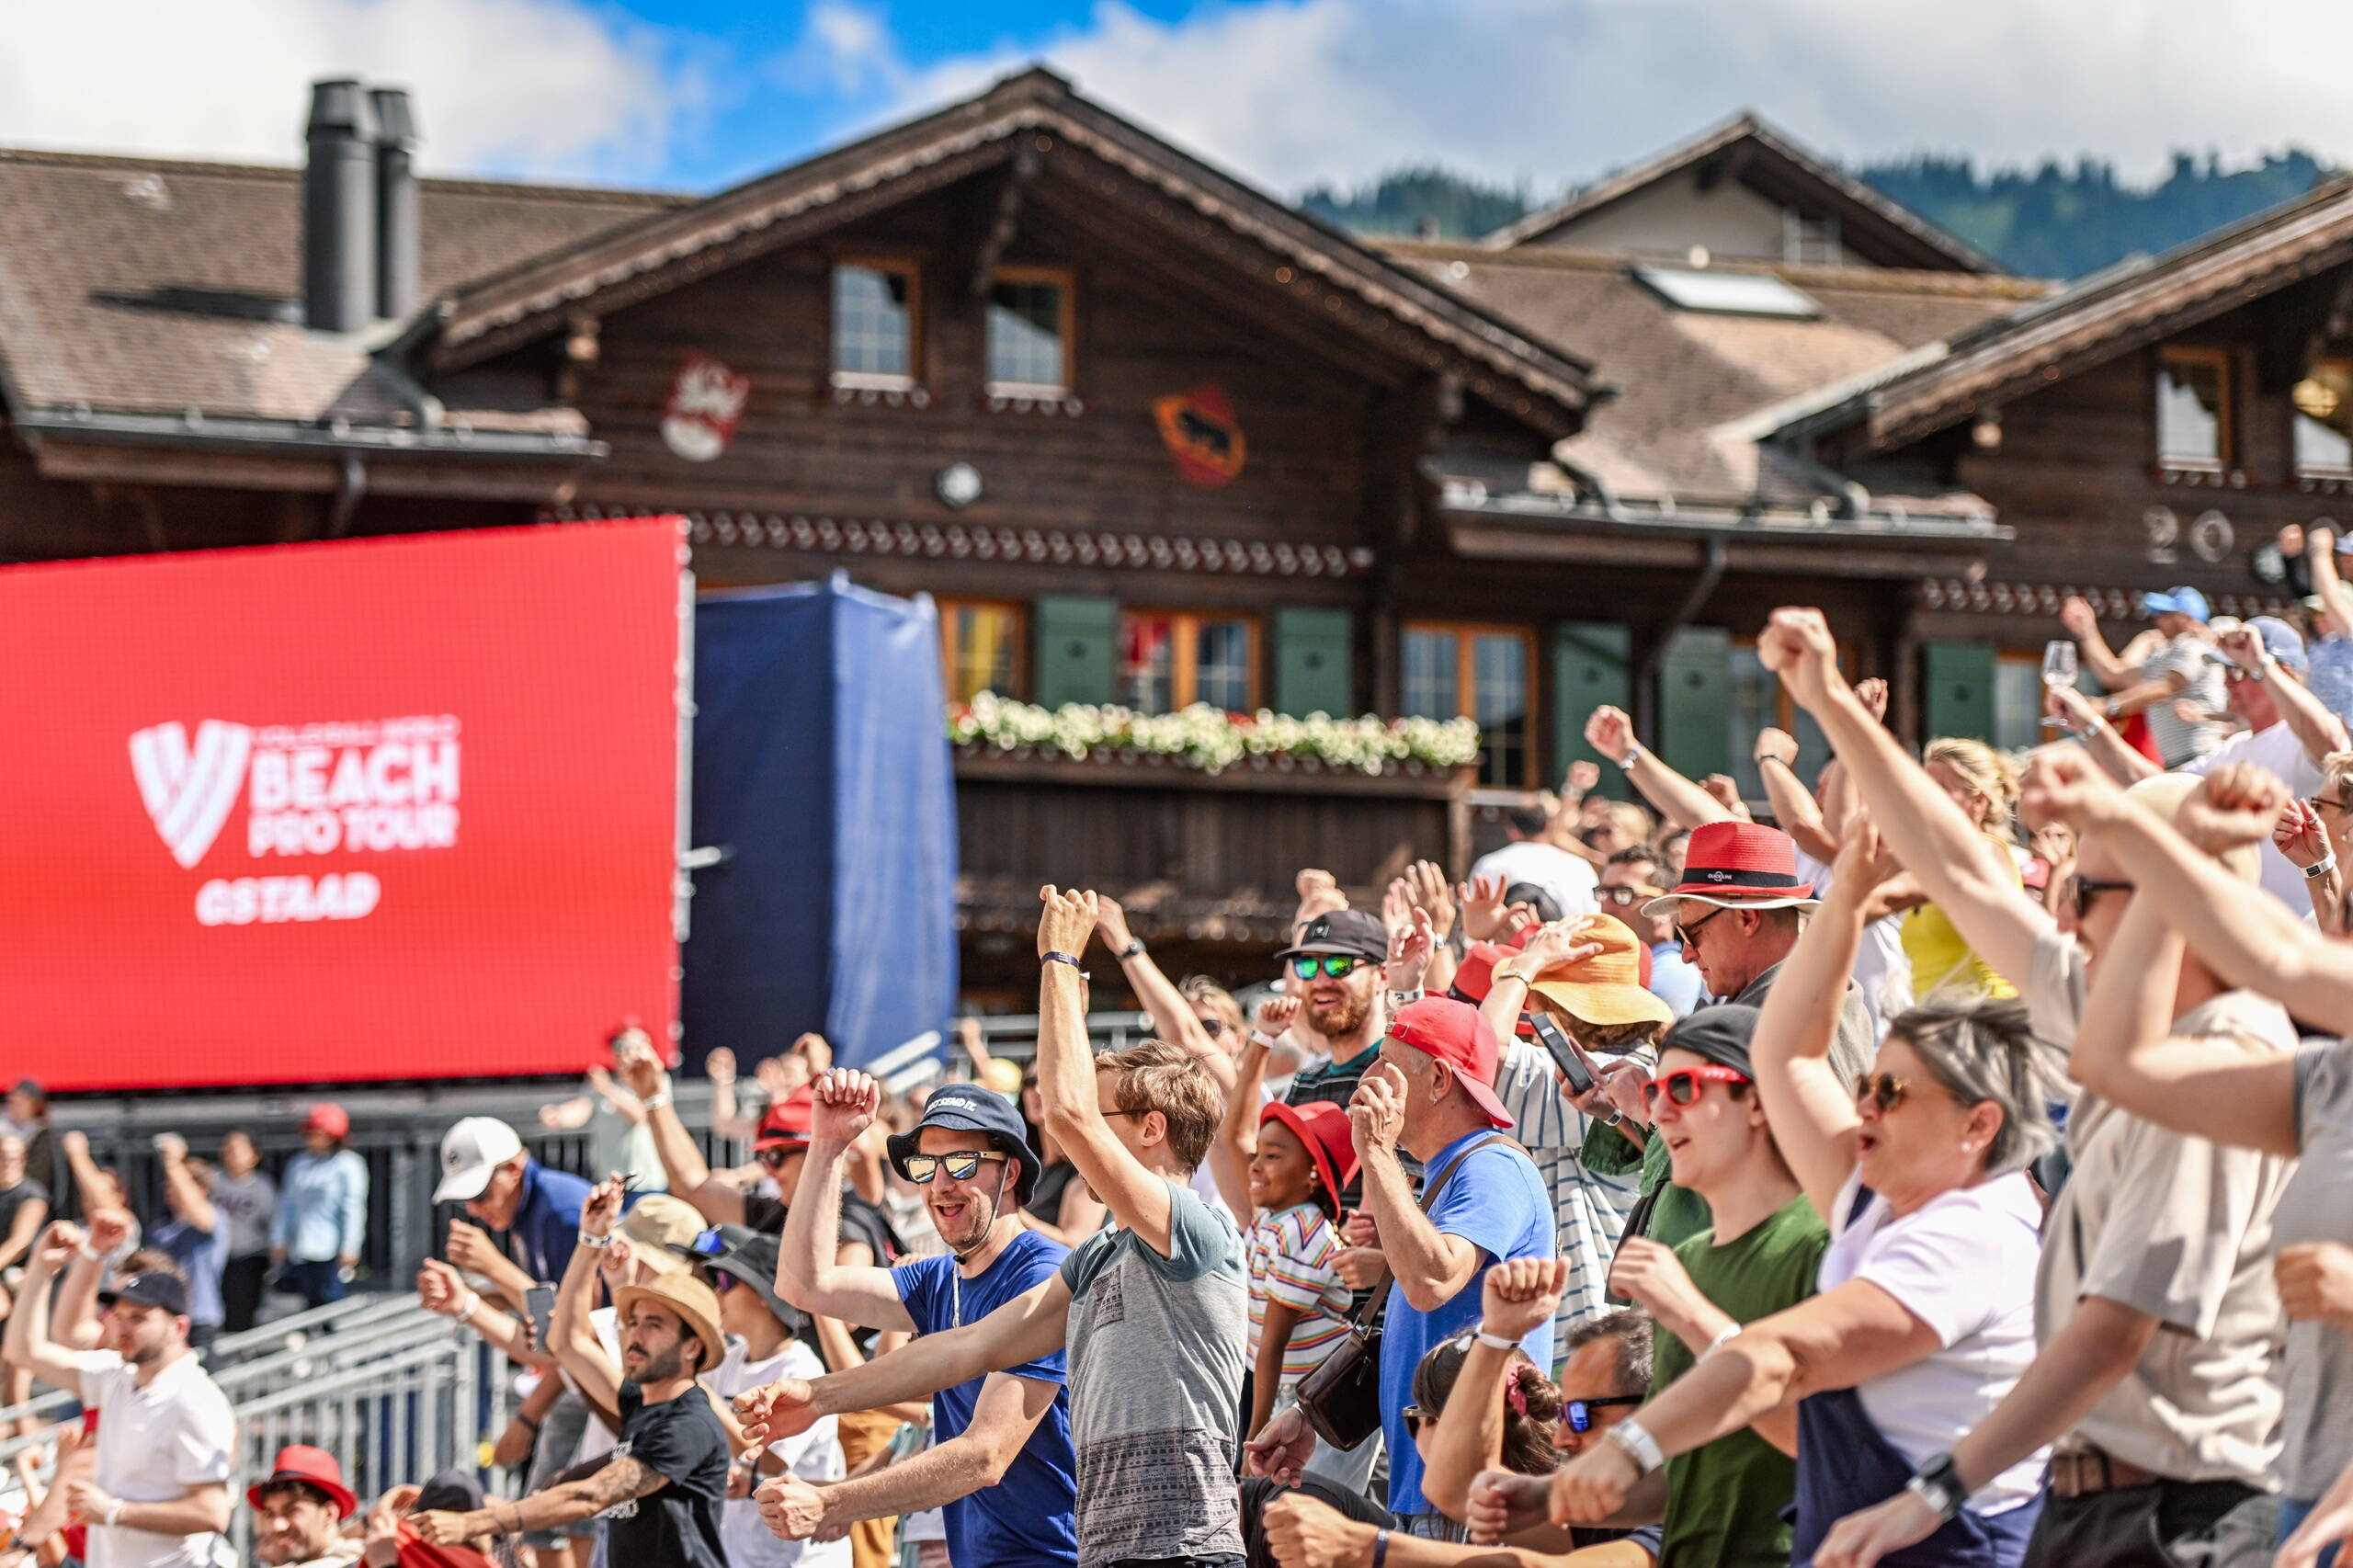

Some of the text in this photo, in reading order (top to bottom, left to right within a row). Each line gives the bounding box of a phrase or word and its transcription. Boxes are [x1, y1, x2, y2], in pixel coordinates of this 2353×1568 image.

[250, 740, 460, 810] BEACH
[248, 803, 459, 858] PRO TOUR
[196, 872, 381, 926] GSTAAD
[941, 1096, 966, 1107] SEND
